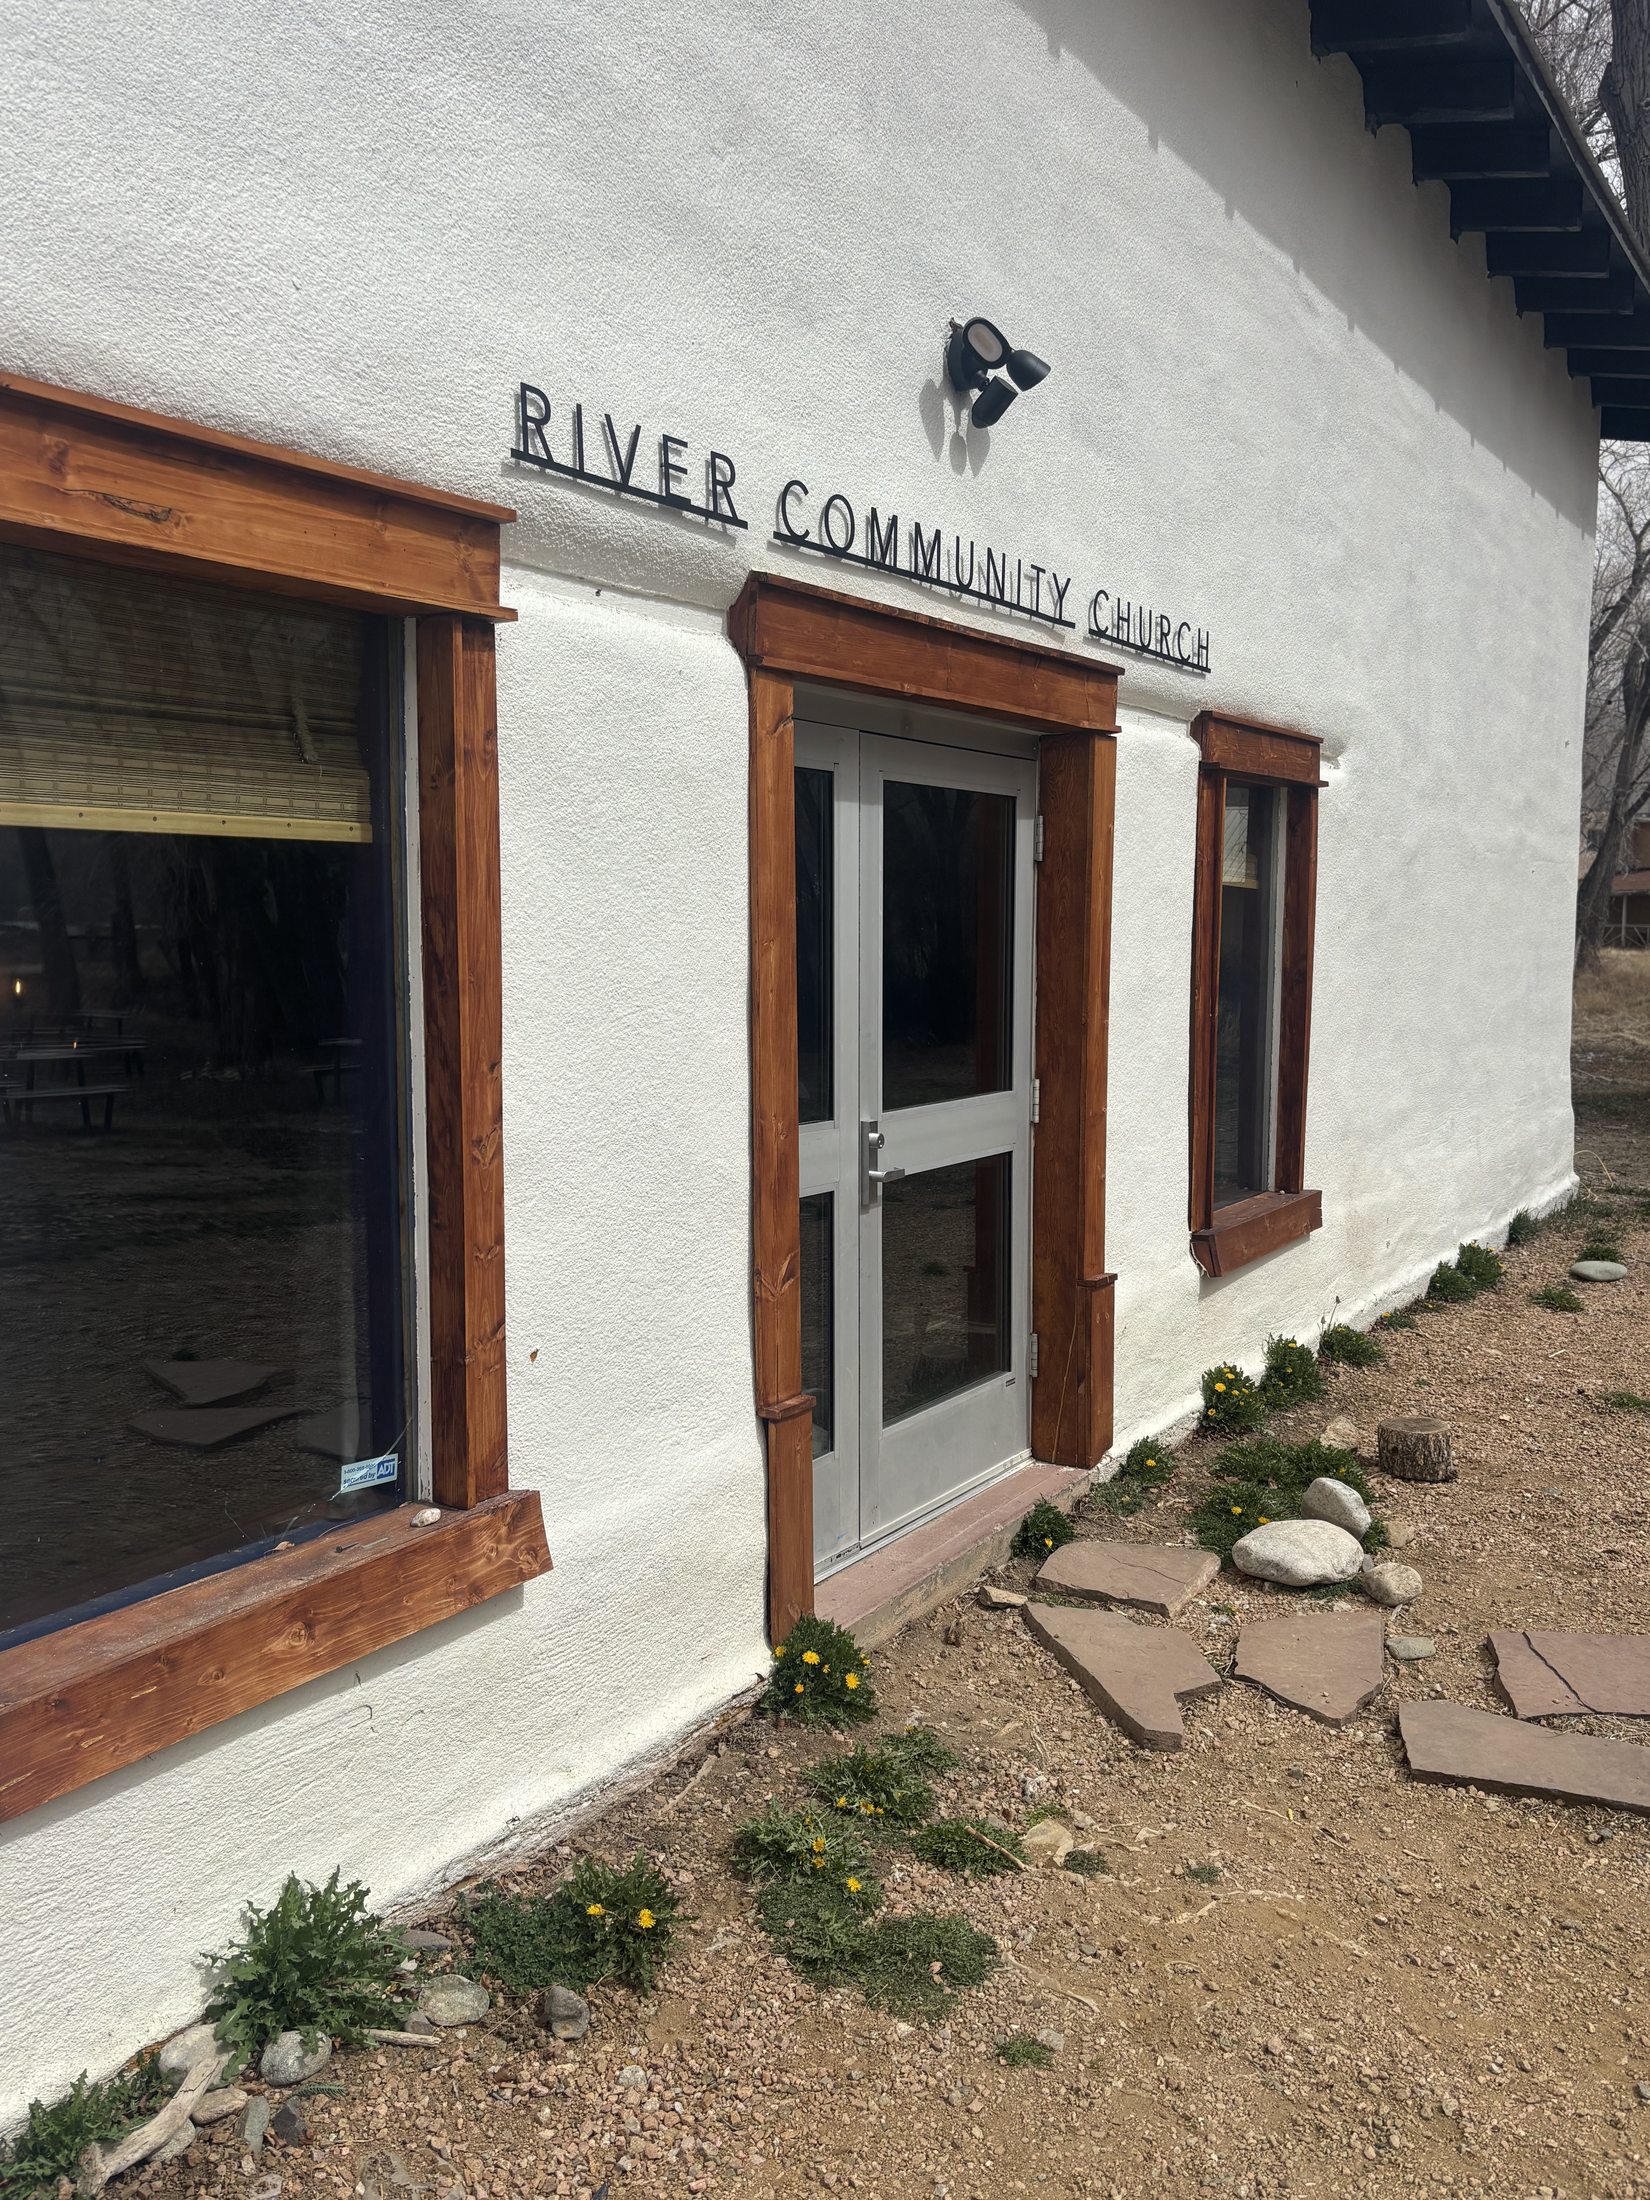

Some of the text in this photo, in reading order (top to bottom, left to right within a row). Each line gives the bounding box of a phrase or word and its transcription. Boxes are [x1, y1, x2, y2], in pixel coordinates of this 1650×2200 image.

[519, 382, 1210, 669] RIVER COMMUNITY CHURCH
[378, 1462, 396, 1476] ADT
